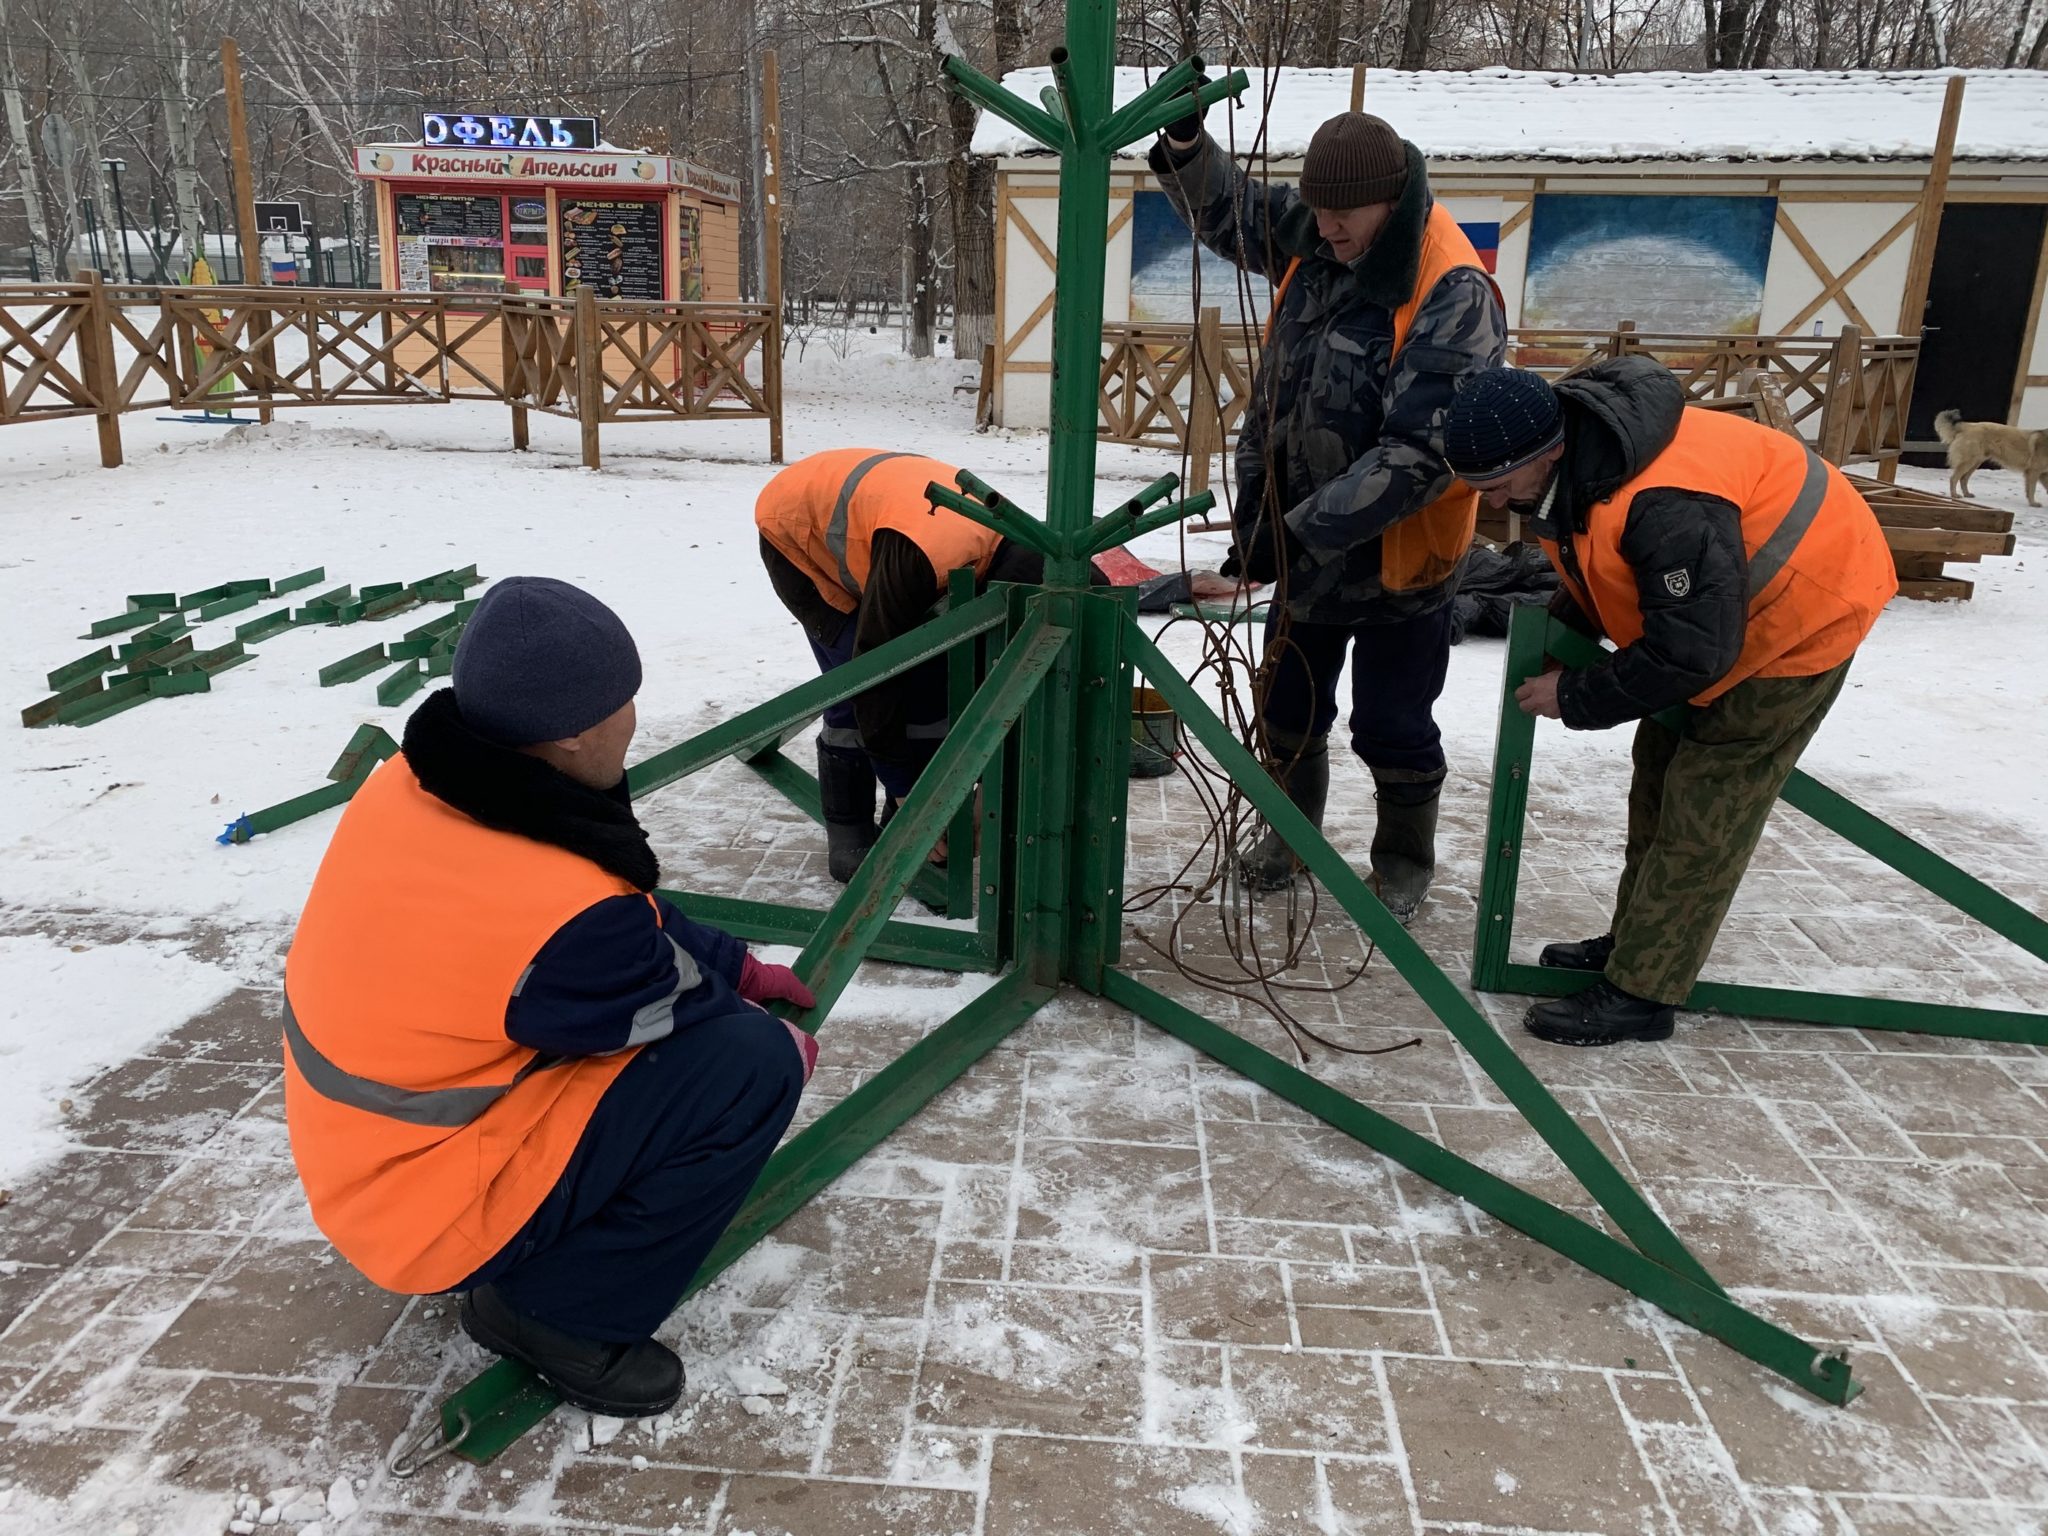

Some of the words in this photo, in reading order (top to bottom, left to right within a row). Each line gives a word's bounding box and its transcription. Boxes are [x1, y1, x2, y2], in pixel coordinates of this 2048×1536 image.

[424, 115, 573, 147] ОФЕЛЬ
[413, 154, 504, 174] Красный
[521, 157, 617, 176] Апельсин
[576, 201, 614, 209] МЕНЮ
[422, 236, 449, 247] Смузи
